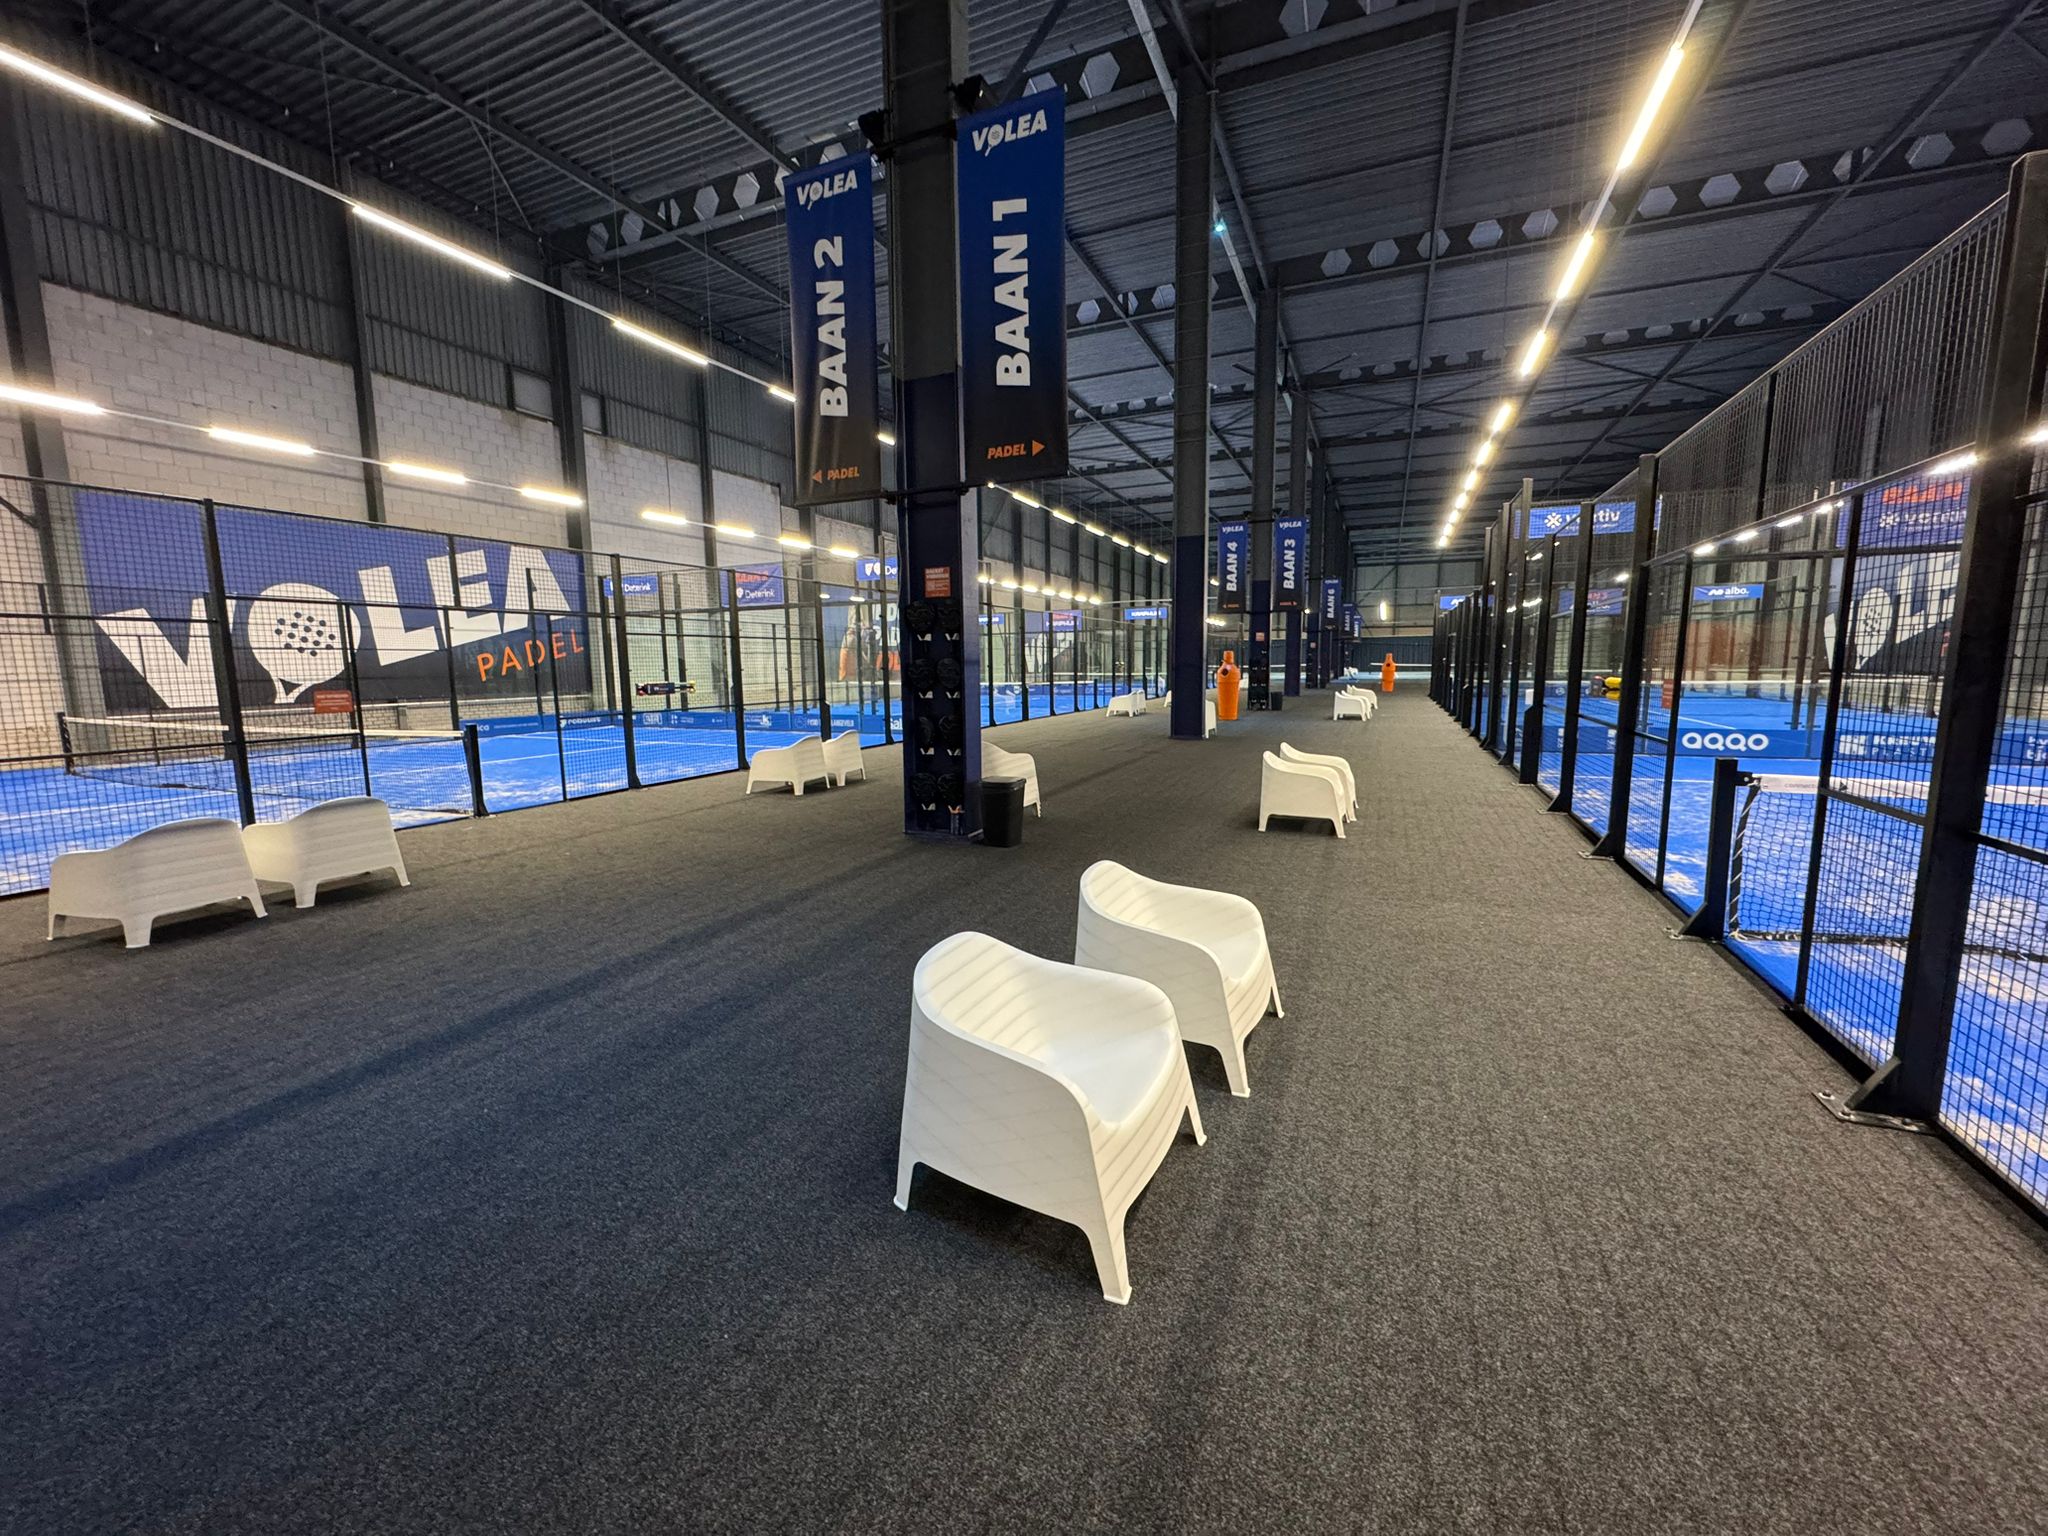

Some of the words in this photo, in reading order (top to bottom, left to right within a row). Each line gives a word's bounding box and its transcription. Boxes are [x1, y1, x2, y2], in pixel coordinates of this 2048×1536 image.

[971, 109, 1048, 157] VOLEA
[797, 169, 858, 210] VOLEA
[992, 197, 1028, 222] 1
[813, 235, 843, 268] 2
[993, 235, 1030, 387] BAAN
[815, 280, 848, 417] BAAN
[987, 444, 1027, 460] PADEL
[827, 466, 860, 480] PADEL
[1227, 541, 1238, 552] 4
[1284, 538, 1296, 548] 3
[1226, 554, 1238, 592] BAAN
[1283, 550, 1296, 589] BAAN
[477, 628, 585, 682] PADEL
